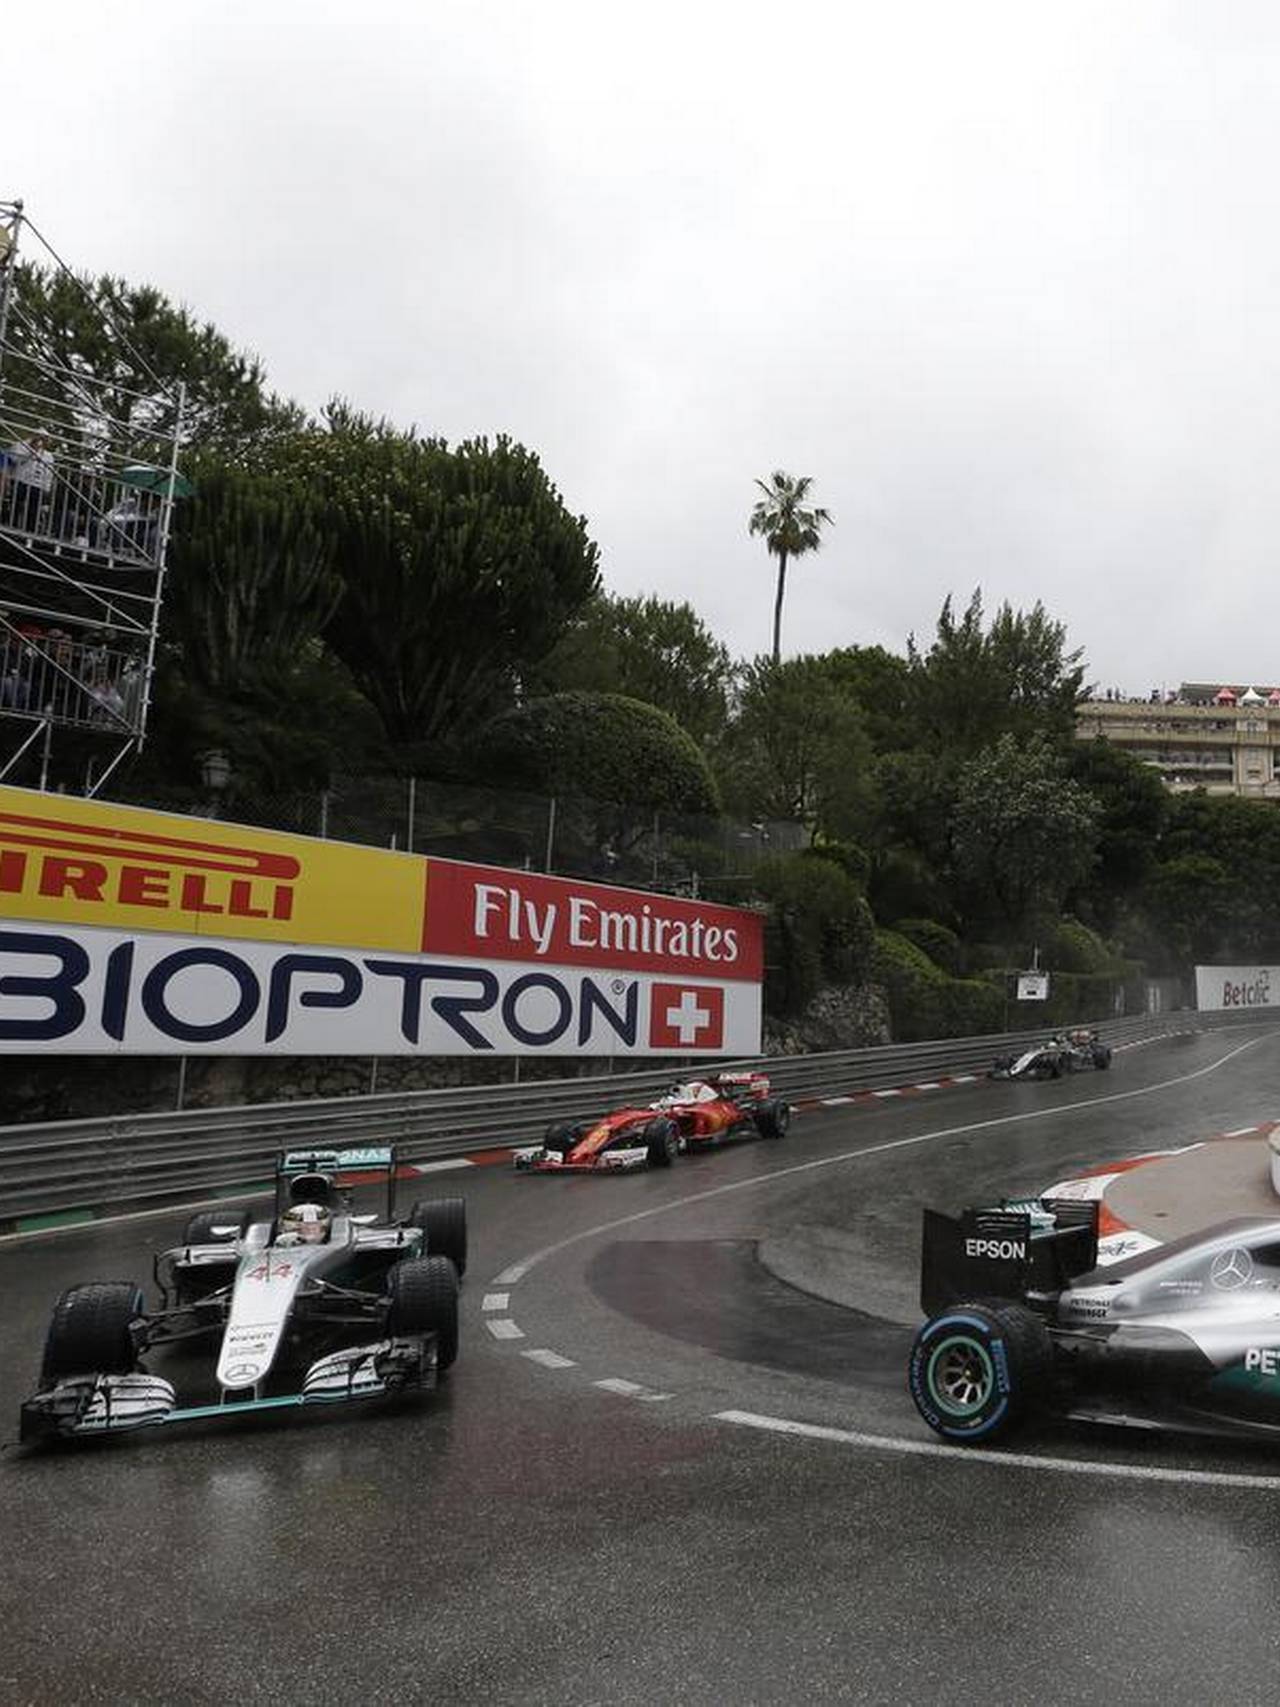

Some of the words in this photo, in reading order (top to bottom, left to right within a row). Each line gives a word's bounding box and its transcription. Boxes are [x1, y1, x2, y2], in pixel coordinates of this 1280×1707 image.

[474, 883, 557, 955] Fly
[569, 896, 738, 962] Emirates
[965, 1238, 1026, 1259] EPSON
